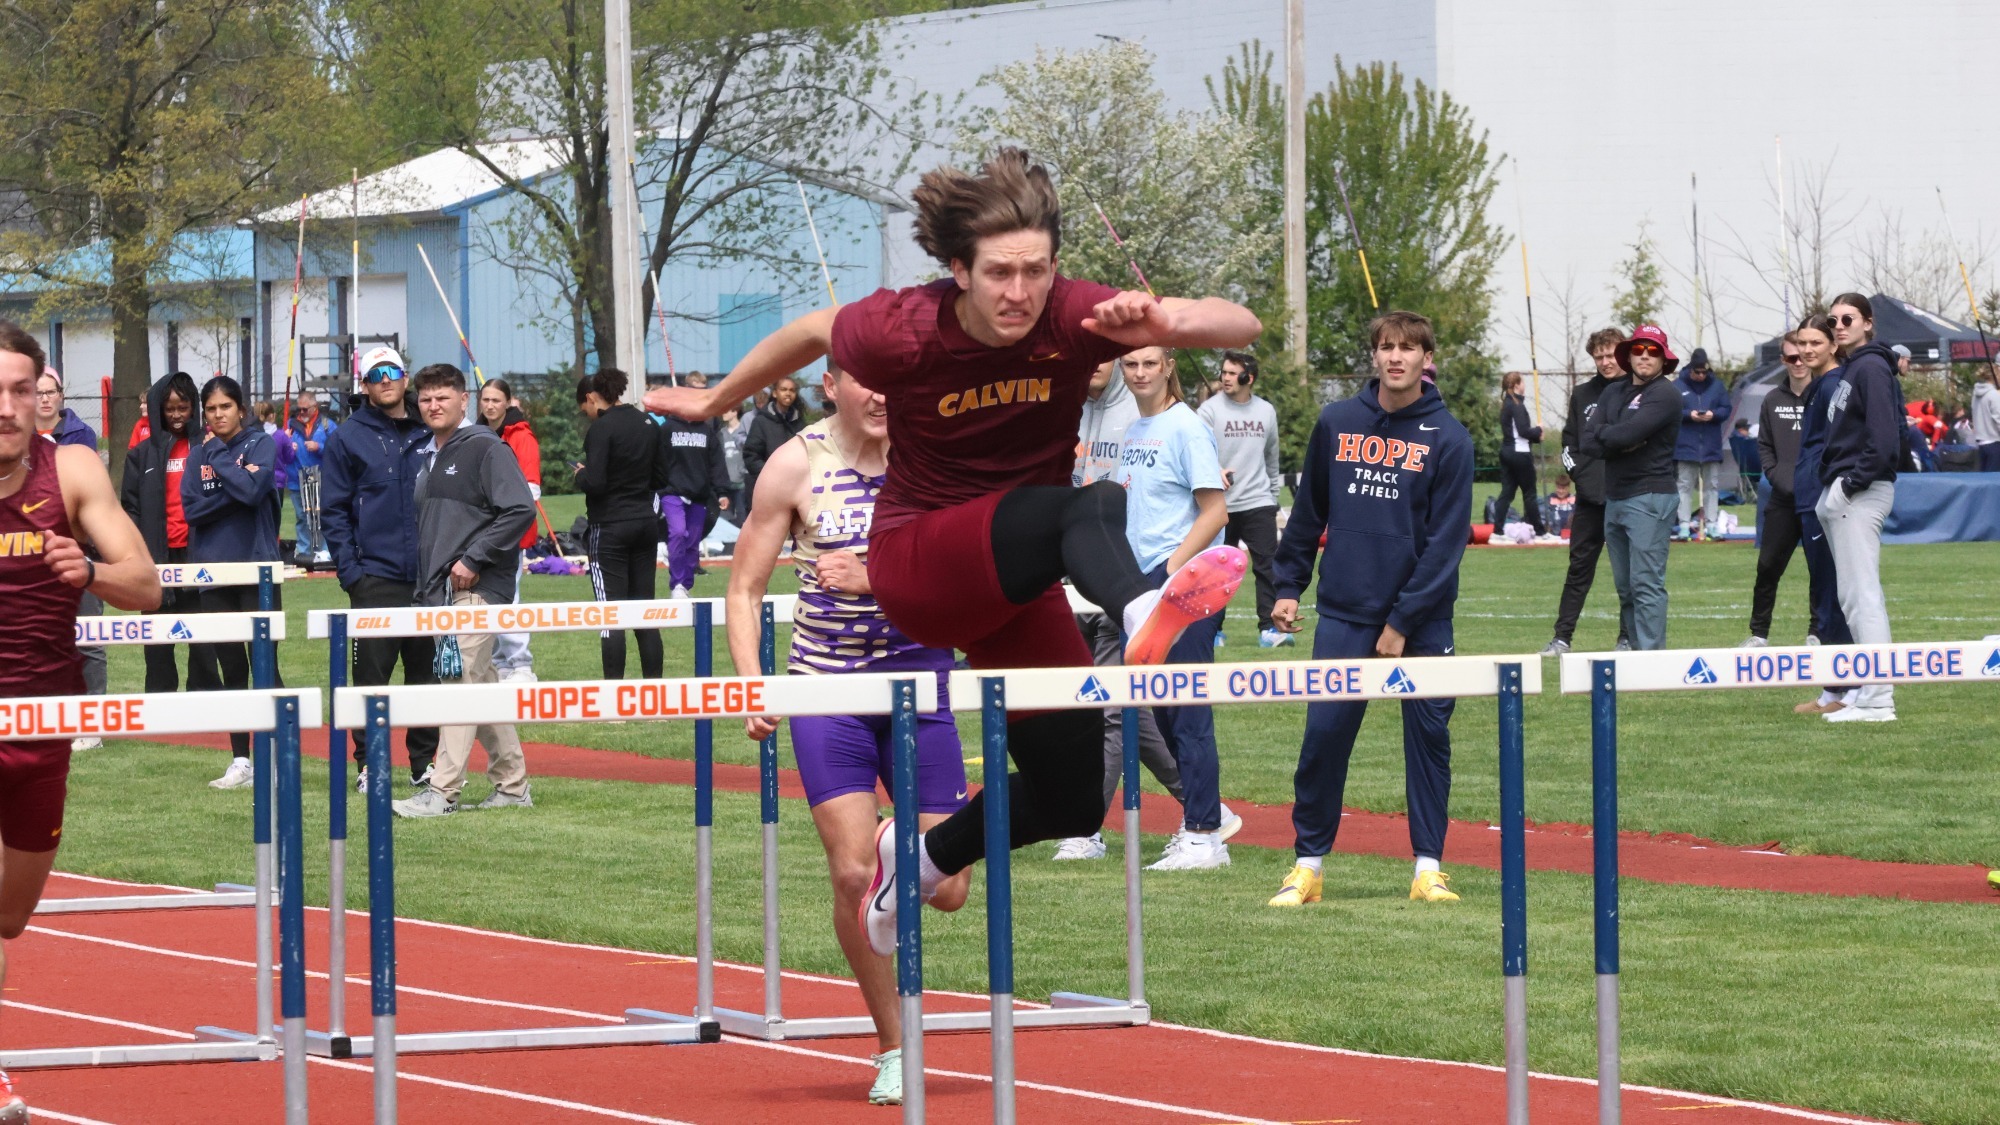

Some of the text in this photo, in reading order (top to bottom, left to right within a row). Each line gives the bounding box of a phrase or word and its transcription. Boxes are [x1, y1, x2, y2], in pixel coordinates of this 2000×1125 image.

[938, 378, 1052, 417] CALVIN
[1224, 420, 1265, 432] ALMA
[1335, 432, 1430, 473] HOPE
[1347, 482, 1399, 500] & FIELD
[1354, 467, 1399, 485] TRACK
[355, 605, 678, 631] GILL HOPE COLLEGE GILL
[1128, 665, 1363, 701] HOPE COLLEGE
[1735, 647, 1964, 683] HOPE COLLEGE
[0, 699, 145, 736] COLLEGE
[516, 681, 765, 720] HOPE COLLEGE
